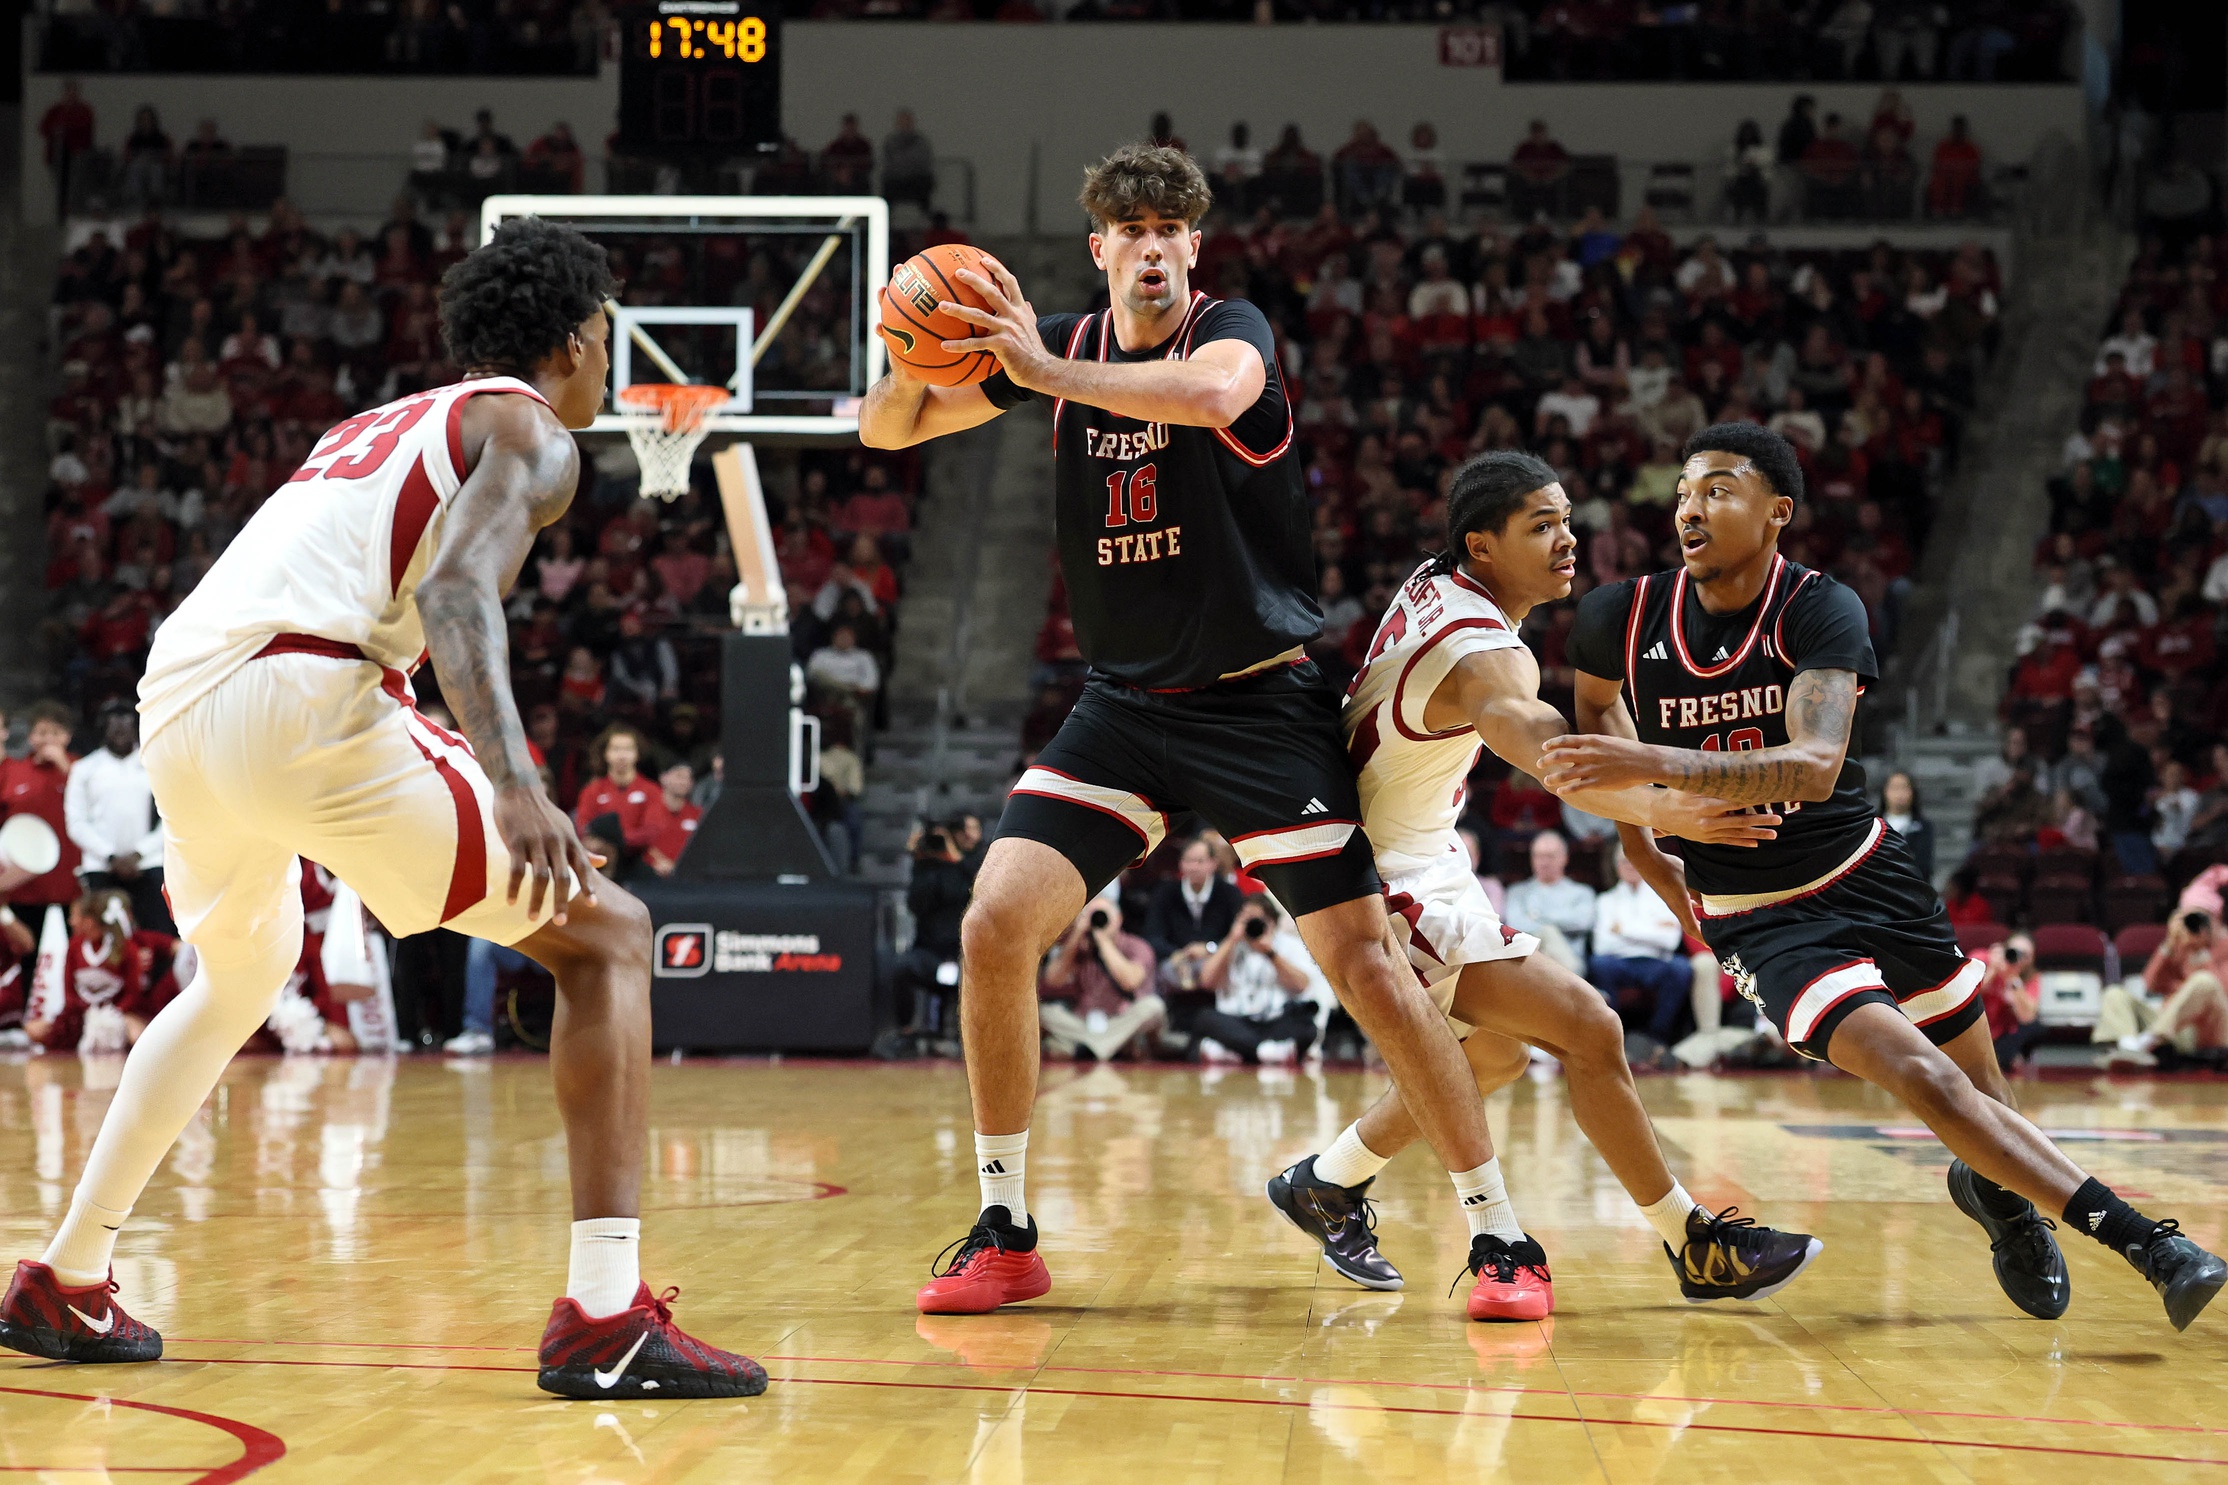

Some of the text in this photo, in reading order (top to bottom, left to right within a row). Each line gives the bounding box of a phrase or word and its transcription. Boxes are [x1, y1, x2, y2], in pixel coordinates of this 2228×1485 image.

[649, 16, 767, 63] 17:48
[1446, 35, 1497, 63] 101
[893, 265, 940, 318] ELITE
[287, 398, 436, 483] 23
[1086, 422, 1169, 461] FRESNO
[1105, 463, 1158, 528] 16
[1098, 526, 1181, 566] STATE
[1404, 563, 1442, 614] CUFF
[1658, 684, 1784, 729] FRESNO
[714, 953, 842, 972] Bank Arena
[715, 930, 820, 954] Simmons
